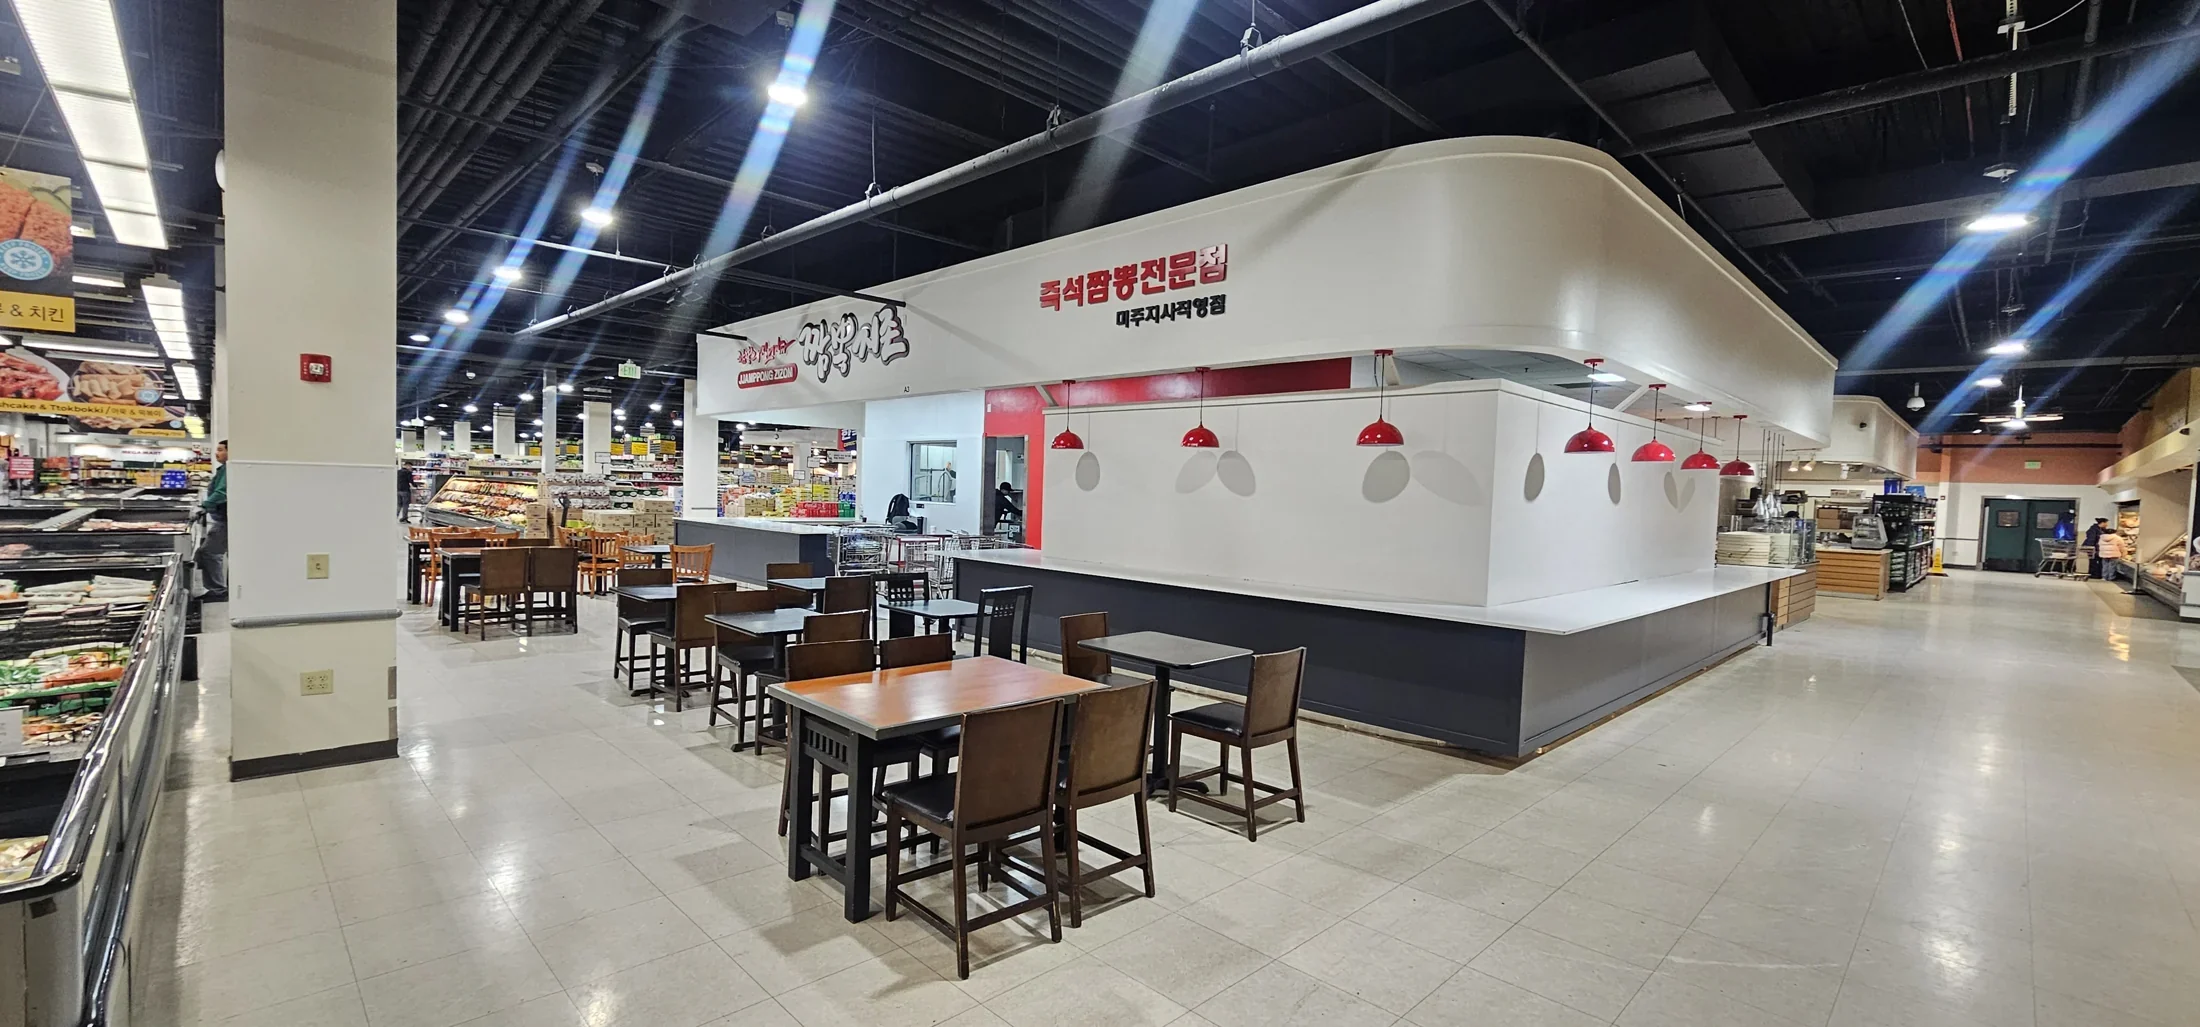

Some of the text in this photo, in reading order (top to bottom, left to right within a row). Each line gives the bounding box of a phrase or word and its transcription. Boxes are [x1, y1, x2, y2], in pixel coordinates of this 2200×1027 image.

[1040, 244, 1229, 311] 즉석짬뽕전문점
[10, 304, 24, 316] &
[29, 305, 65, 323] 치킨
[50, 404, 104, 414] Ttokbokki
